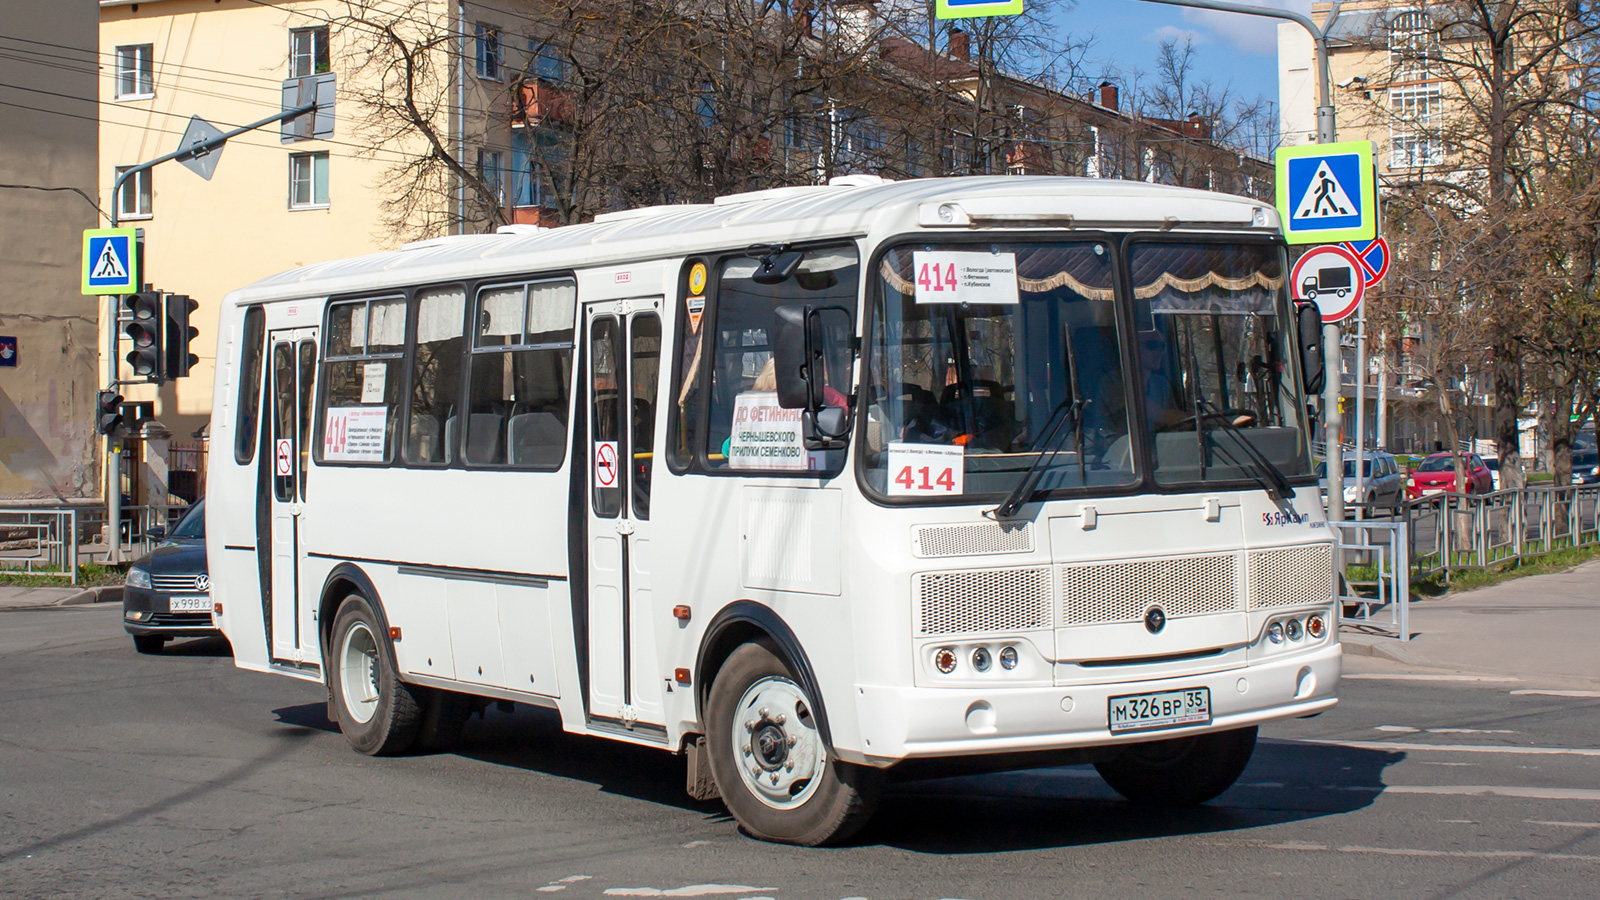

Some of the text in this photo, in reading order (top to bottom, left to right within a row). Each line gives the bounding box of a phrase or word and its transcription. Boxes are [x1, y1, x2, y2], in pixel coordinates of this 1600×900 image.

[918, 263, 958, 292] 414
[735, 406, 749, 426] ДО
[326, 415, 348, 454] 414
[738, 431, 796, 443] ЧЕРНЫШЕВСКОГО
[731, 445, 760, 457] ПРИЛУКИ
[760, 446, 801, 458] СЕМЕНКОВО
[895, 465, 956, 492] 414
[1116, 691, 1203, 721] М326ВР 35
